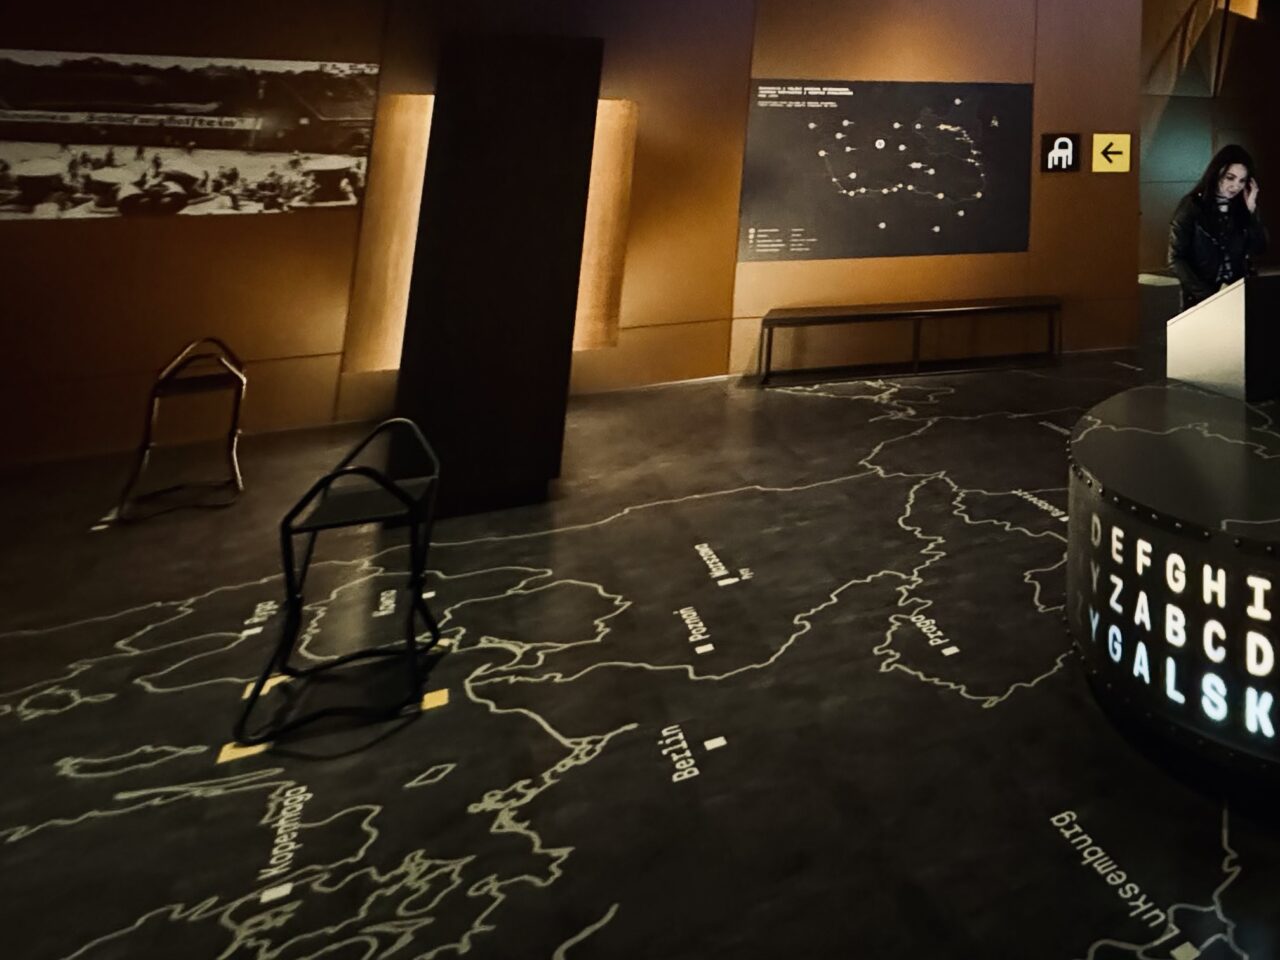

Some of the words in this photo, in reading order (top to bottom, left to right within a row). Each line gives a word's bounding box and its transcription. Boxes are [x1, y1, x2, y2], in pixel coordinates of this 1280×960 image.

[673, 606, 711, 642] Poznań
[657, 725, 700, 783] Berlin
[1050, 810, 1180, 946] Luksemburg
